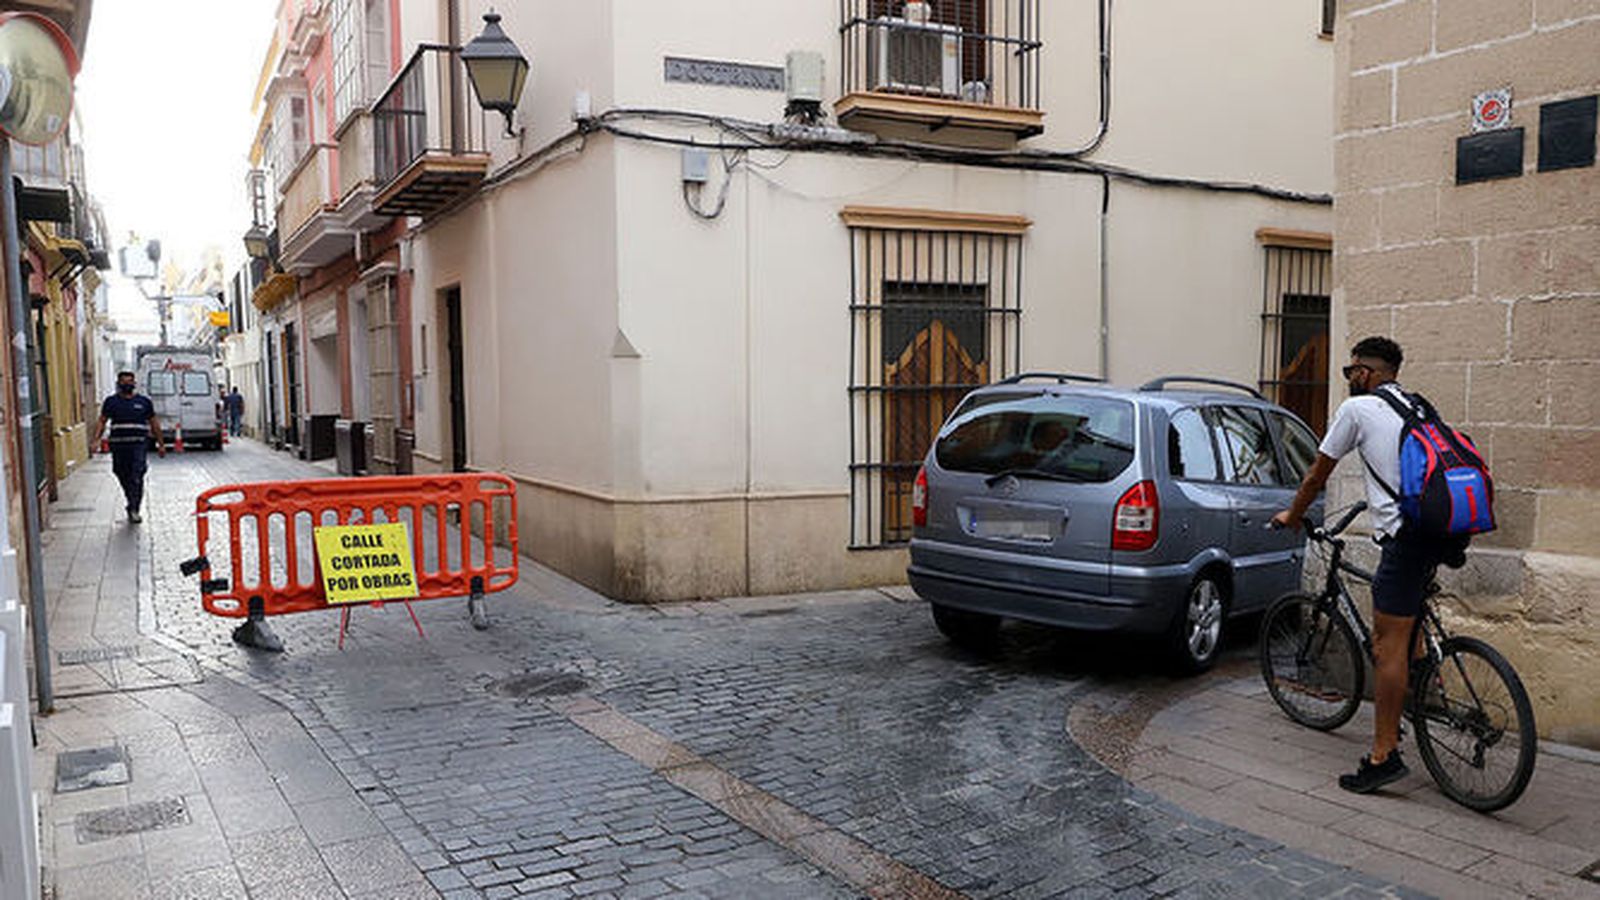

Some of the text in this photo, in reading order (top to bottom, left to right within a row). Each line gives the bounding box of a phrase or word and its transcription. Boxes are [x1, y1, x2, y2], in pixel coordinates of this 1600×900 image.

[340, 534, 384, 549] CALLE
[331, 553, 402, 571] CORTADA
[327, 572, 412, 592] POR OBRAS
